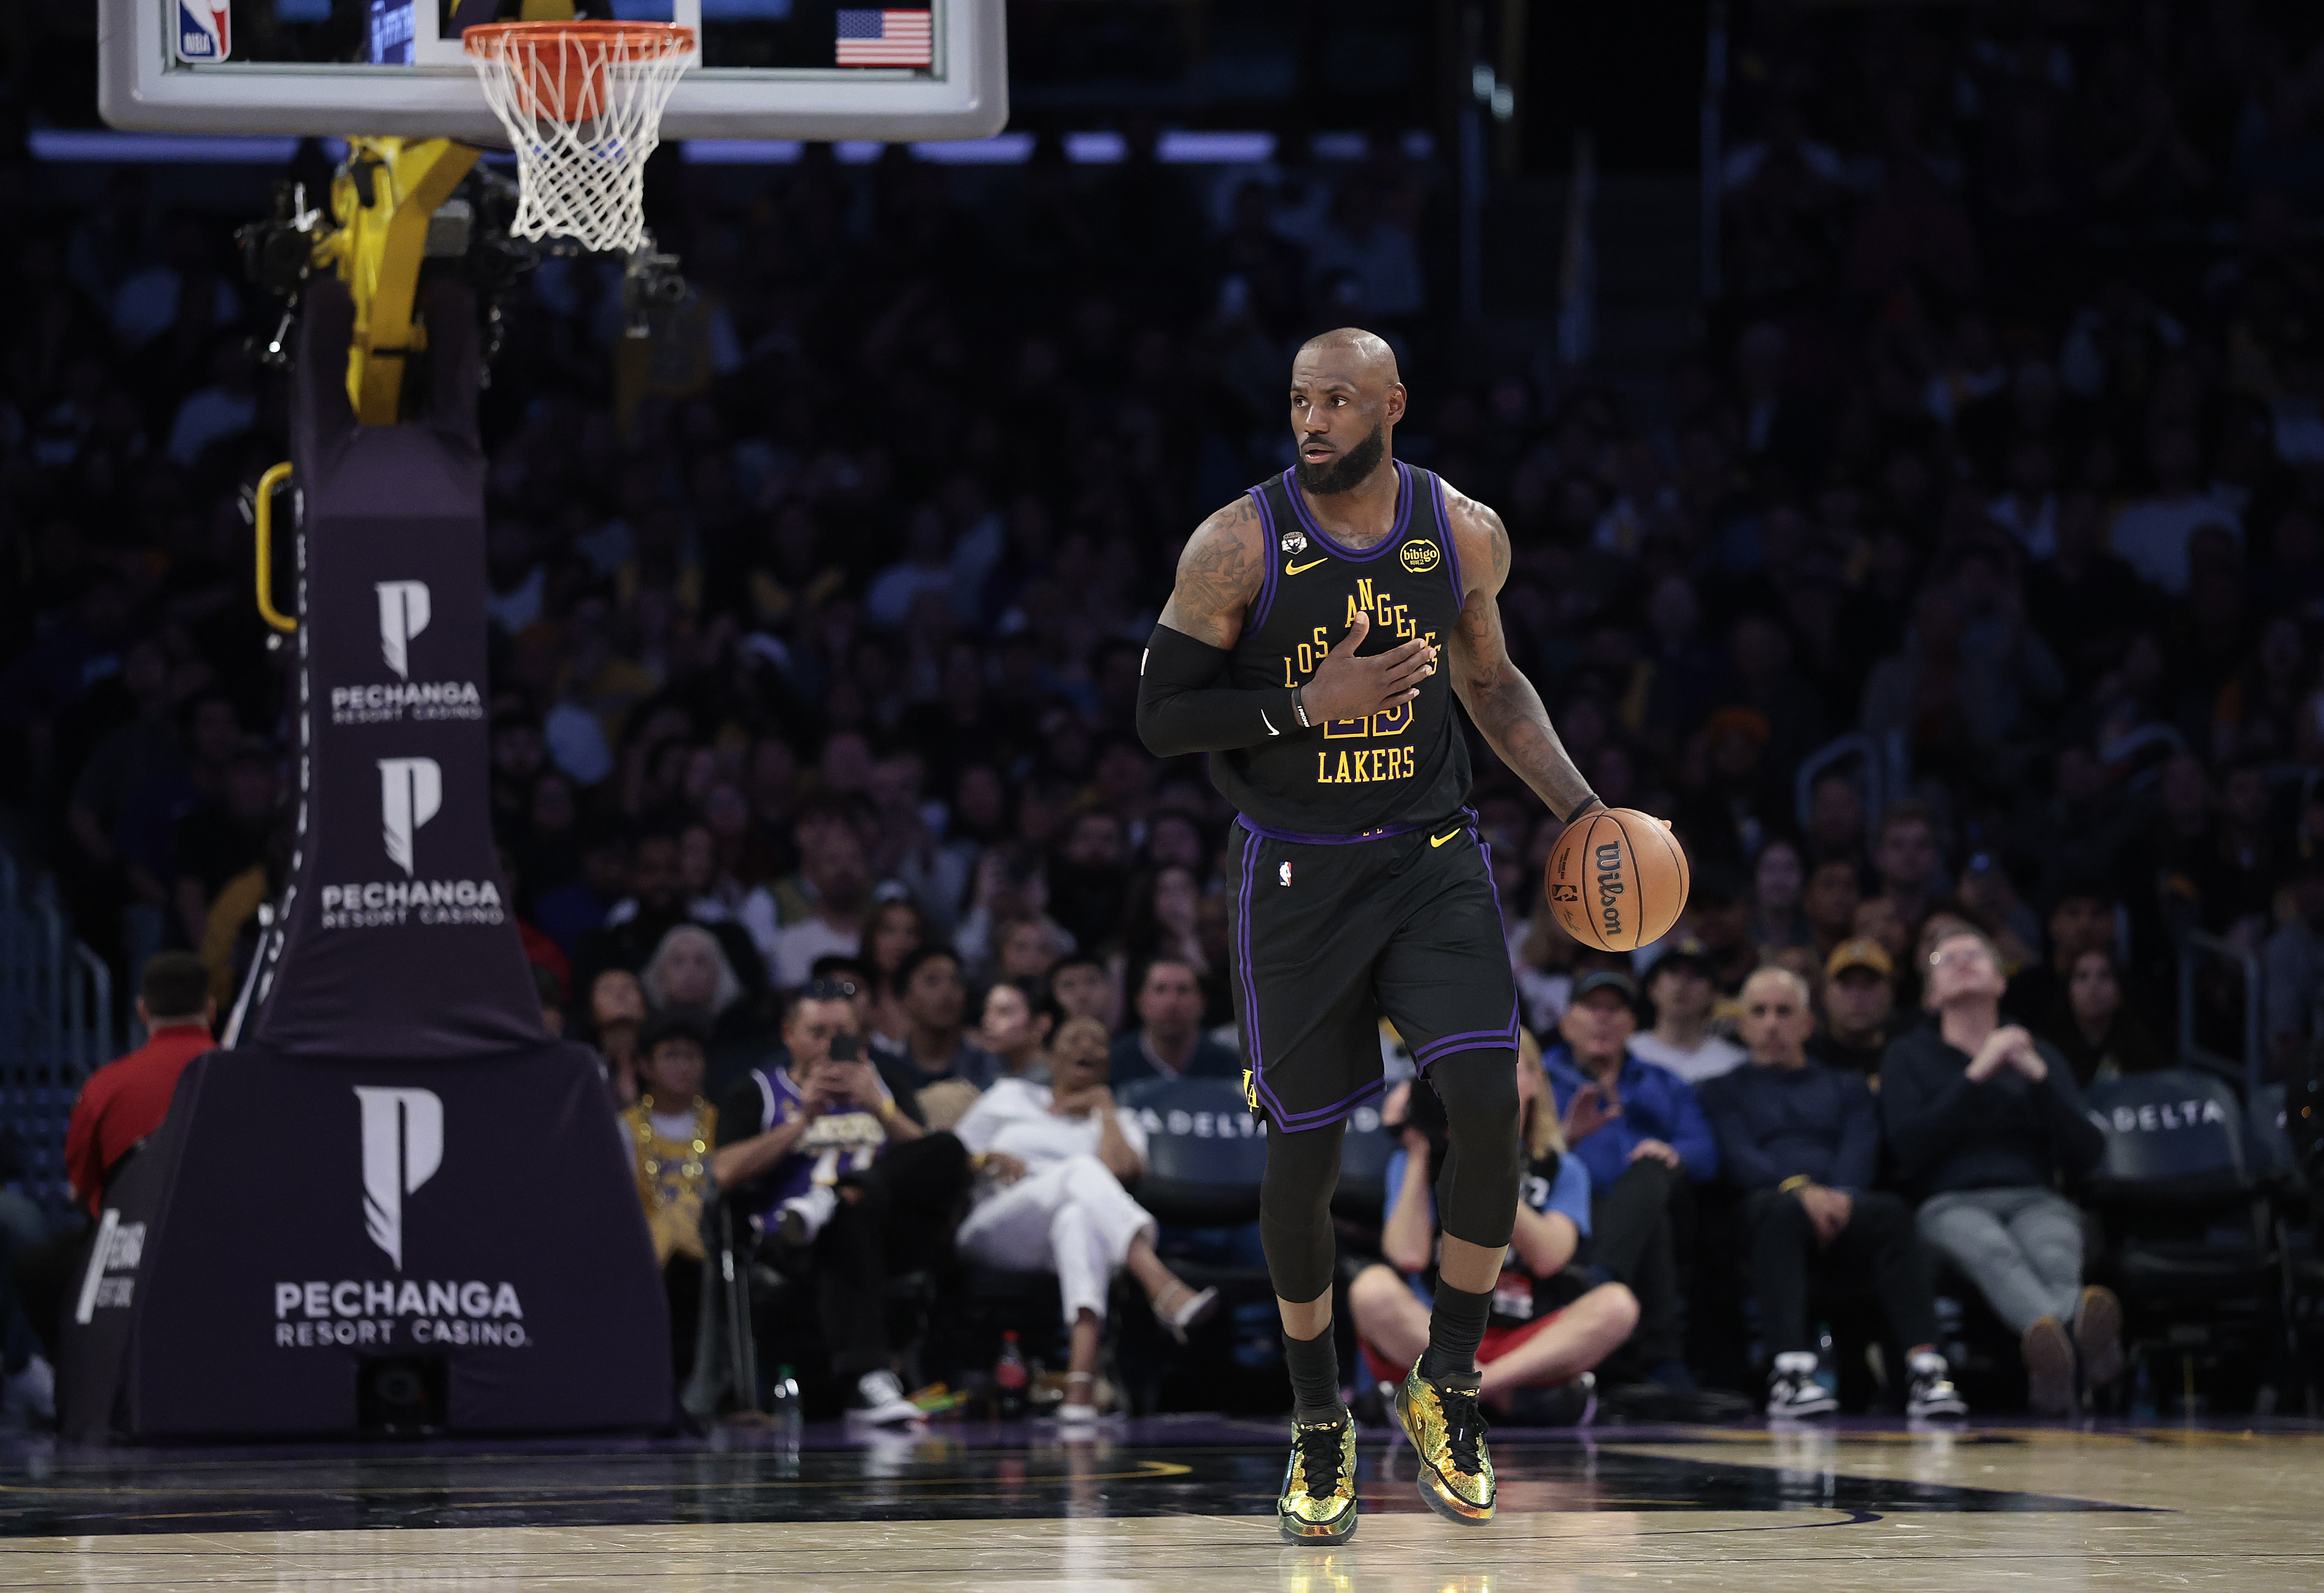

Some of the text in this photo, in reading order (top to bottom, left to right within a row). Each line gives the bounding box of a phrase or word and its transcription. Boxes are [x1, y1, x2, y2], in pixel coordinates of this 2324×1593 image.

[184, 32, 211, 54] NBA
[1404, 548, 1437, 562] bibigo
[1285, 627, 1329, 688] LOS
[331, 681, 480, 710] PECHANGA
[1298, 708, 1311, 728] PROMIS
[1318, 746, 1414, 783] LAKERS
[321, 879, 502, 910] PECHANGA
[1596, 840, 1625, 935] Wilson
[2112, 1098, 2225, 1133] DELTA
[275, 1280, 523, 1319] PECHANGA
[275, 1318, 526, 1347] RESORT CASINO
